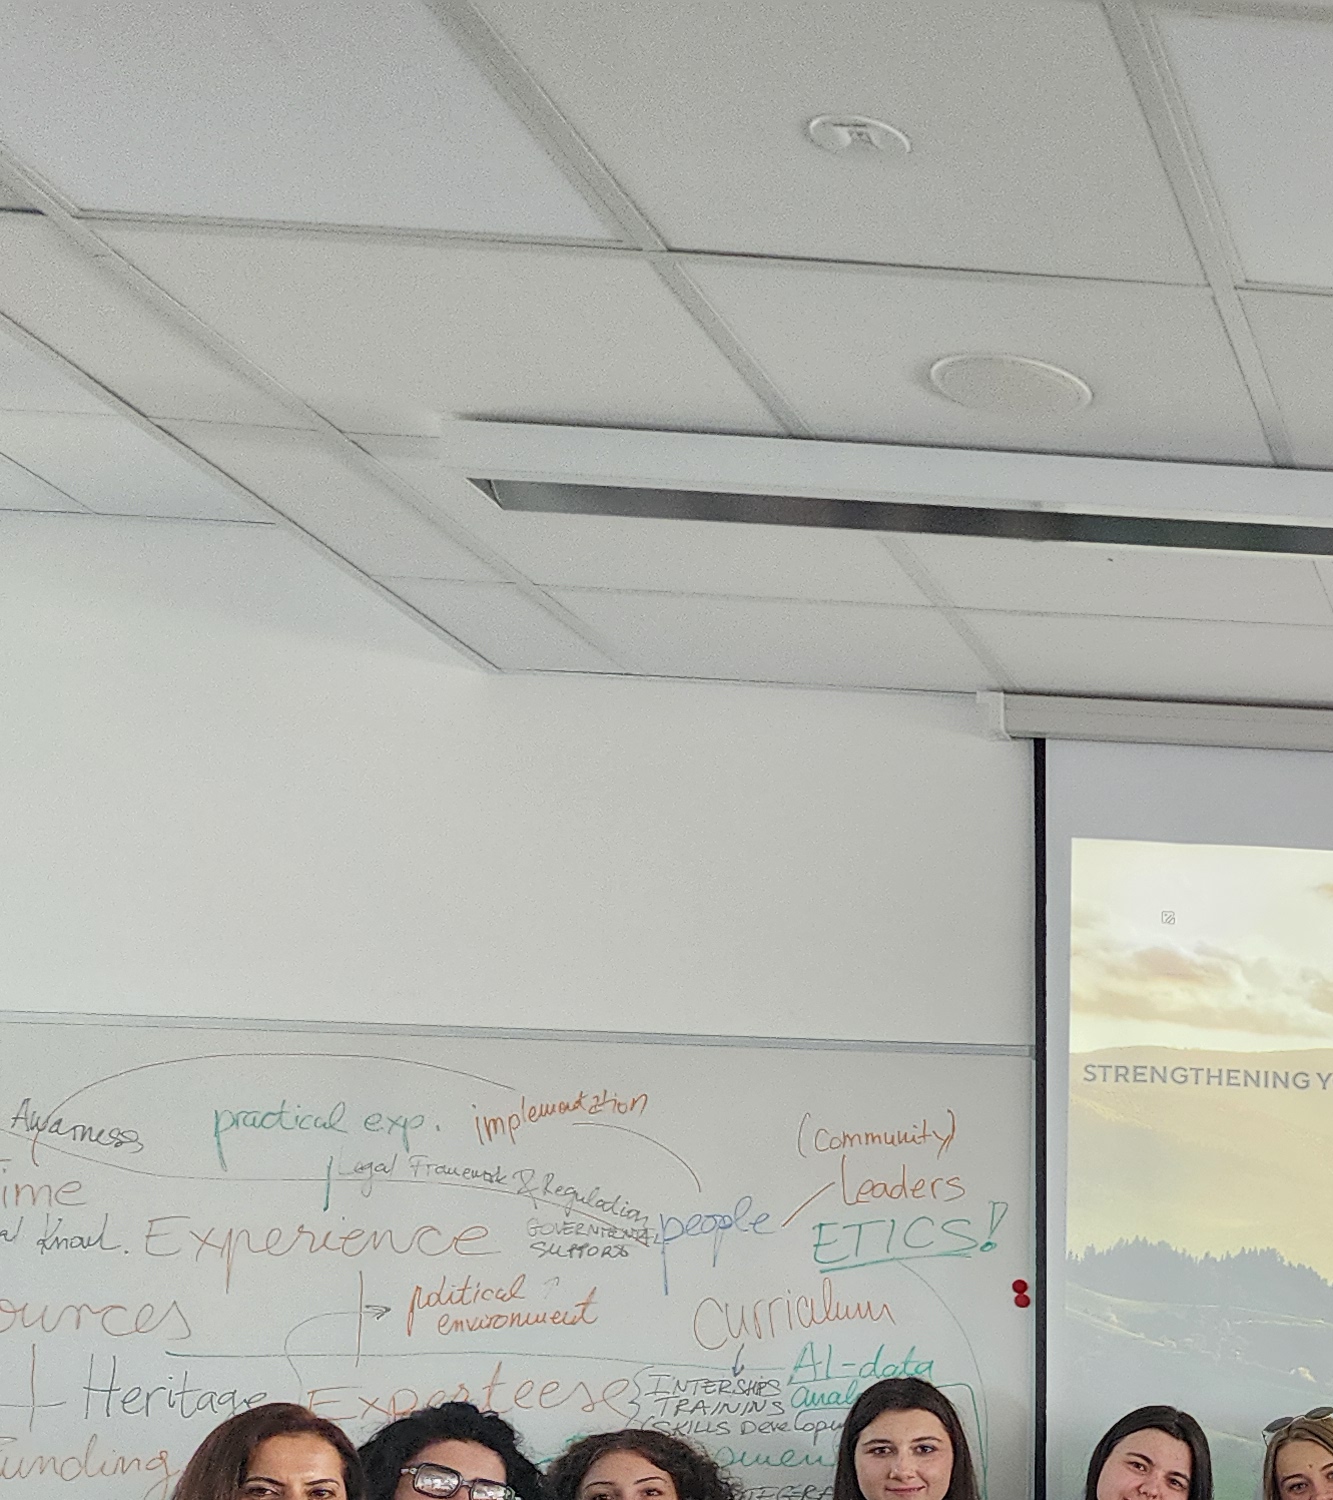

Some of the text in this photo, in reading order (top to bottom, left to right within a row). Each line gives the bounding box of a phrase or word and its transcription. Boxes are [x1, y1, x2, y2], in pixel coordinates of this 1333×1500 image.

[1083, 1064, 1311, 1090] STRENGTHENING
[214, 1100, 441, 1172] practical exp.
[0, 1158, 87, 1209] ime
[145, 1213, 500, 1294] Experience
[659, 1196, 775, 1296] people
